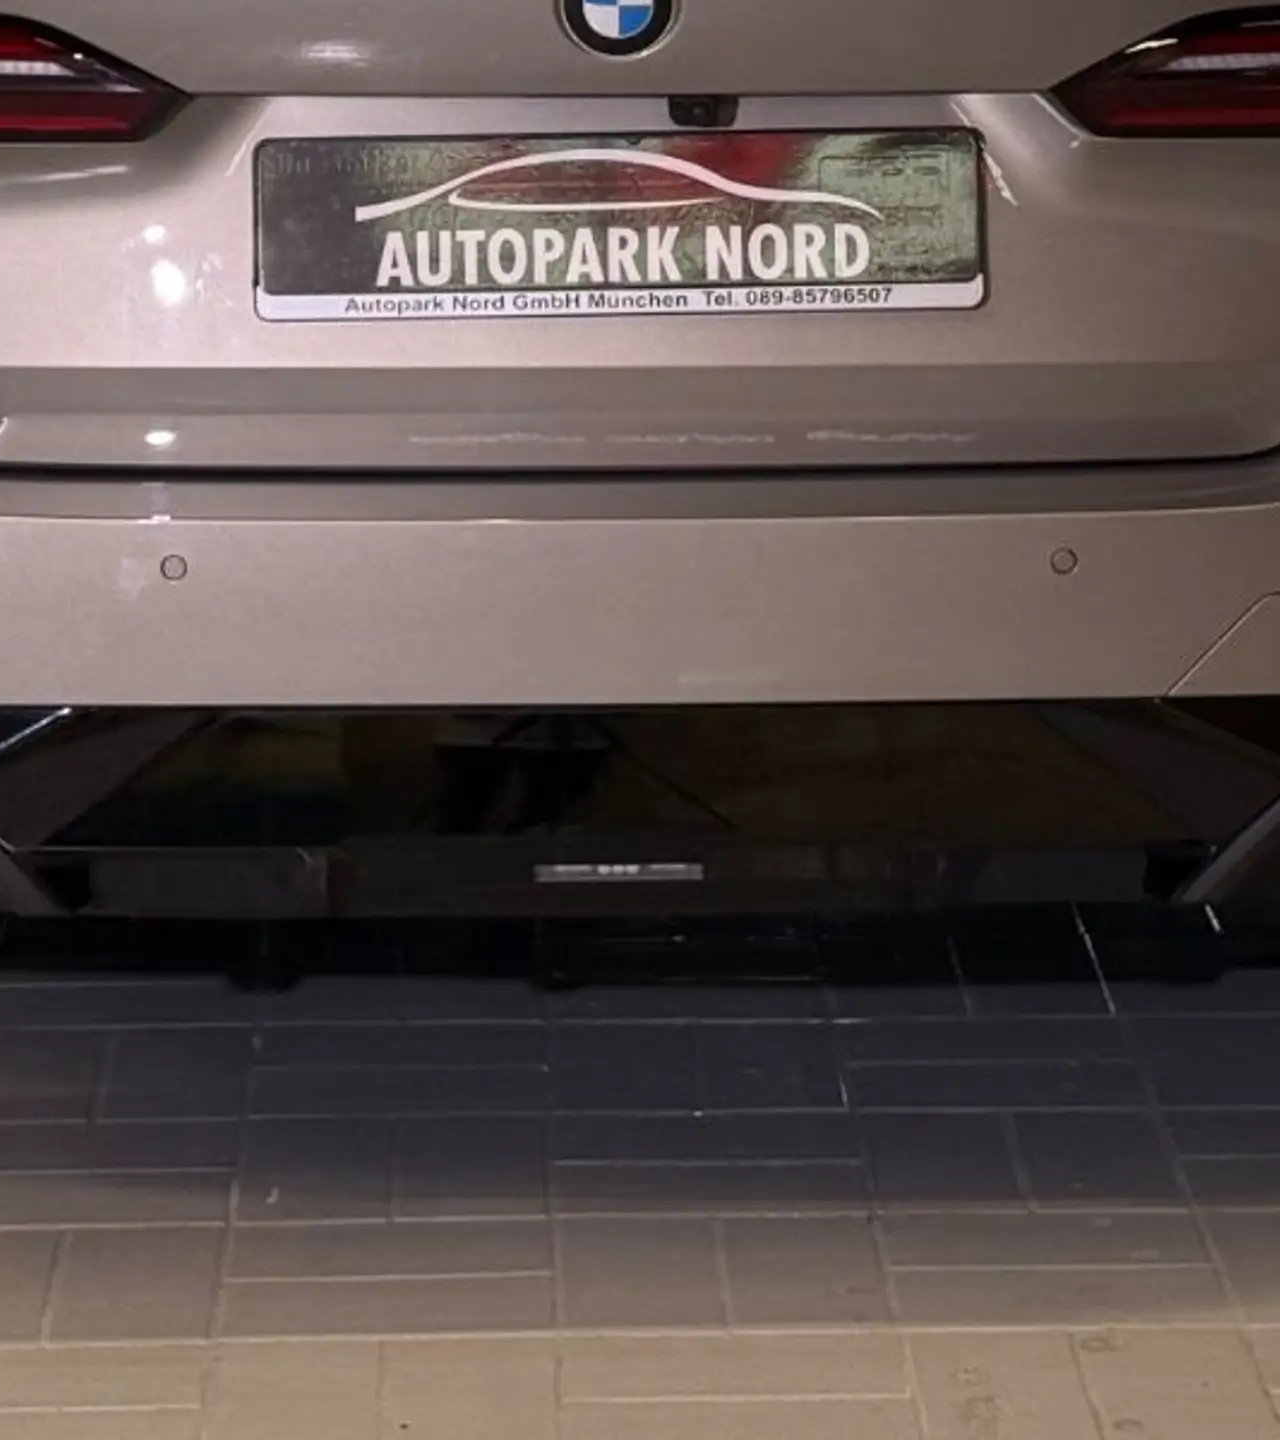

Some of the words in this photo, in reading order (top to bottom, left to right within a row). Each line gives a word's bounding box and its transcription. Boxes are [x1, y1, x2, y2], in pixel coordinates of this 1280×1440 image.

[376, 227, 681, 287] AUTOPARK
[704, 224, 870, 280] NORD
[345, 296, 445, 317] Autopark
[452, 295, 505, 311] Nord
[512, 294, 580, 310] GmbH
[704, 290, 738, 306] Tel.
[745, 287, 892, 305] 089-85796507
